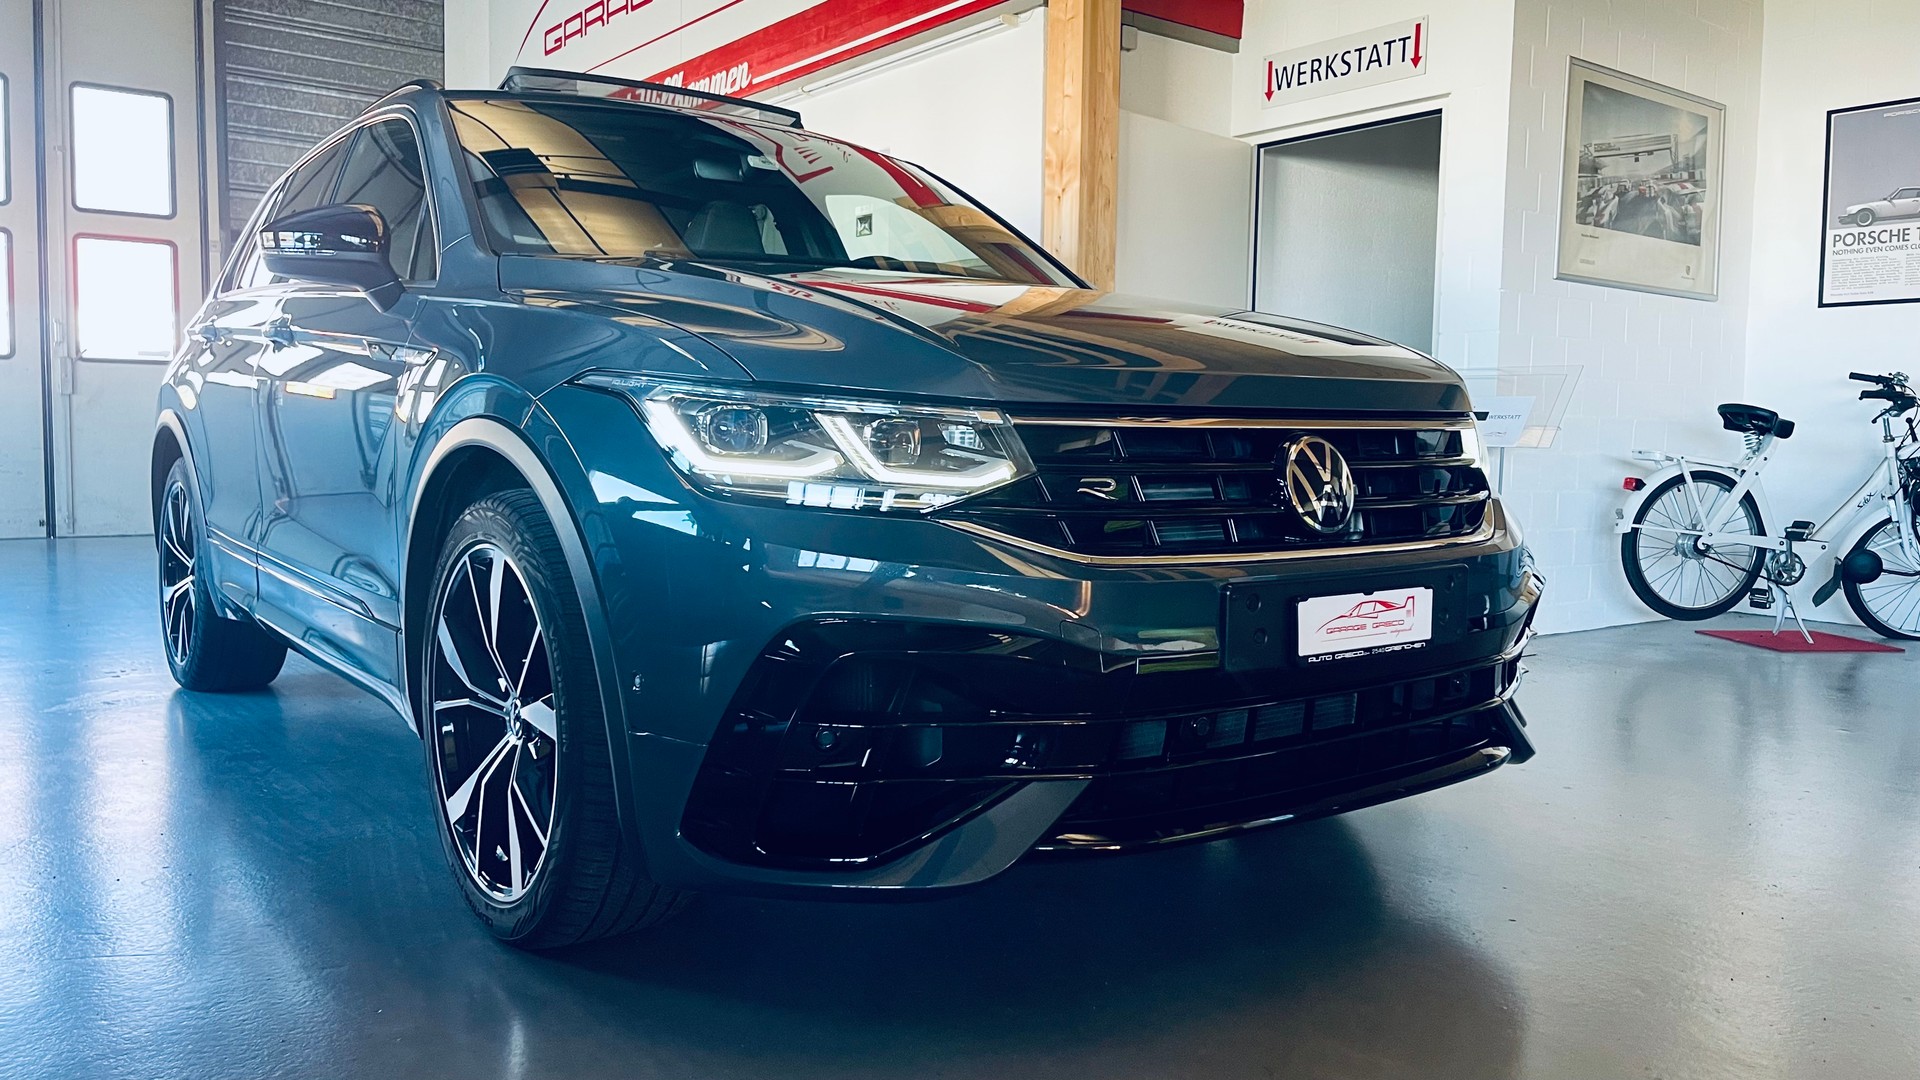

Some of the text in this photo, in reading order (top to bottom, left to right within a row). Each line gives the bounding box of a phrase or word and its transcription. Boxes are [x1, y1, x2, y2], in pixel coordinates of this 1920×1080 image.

[1275, 35, 1412, 91] WERKSTATT
[1833, 227, 1911, 248] PORSCHE
[1832, 248, 1864, 256] NOTHING
[1865, 246, 1884, 254] EVEN
[1885, 244, 1909, 252] COMES
[1326, 619, 1405, 634] GARAGE GRECO
[1308, 654, 1333, 663] AUTO
[1335, 650, 1365, 660] GRECO
